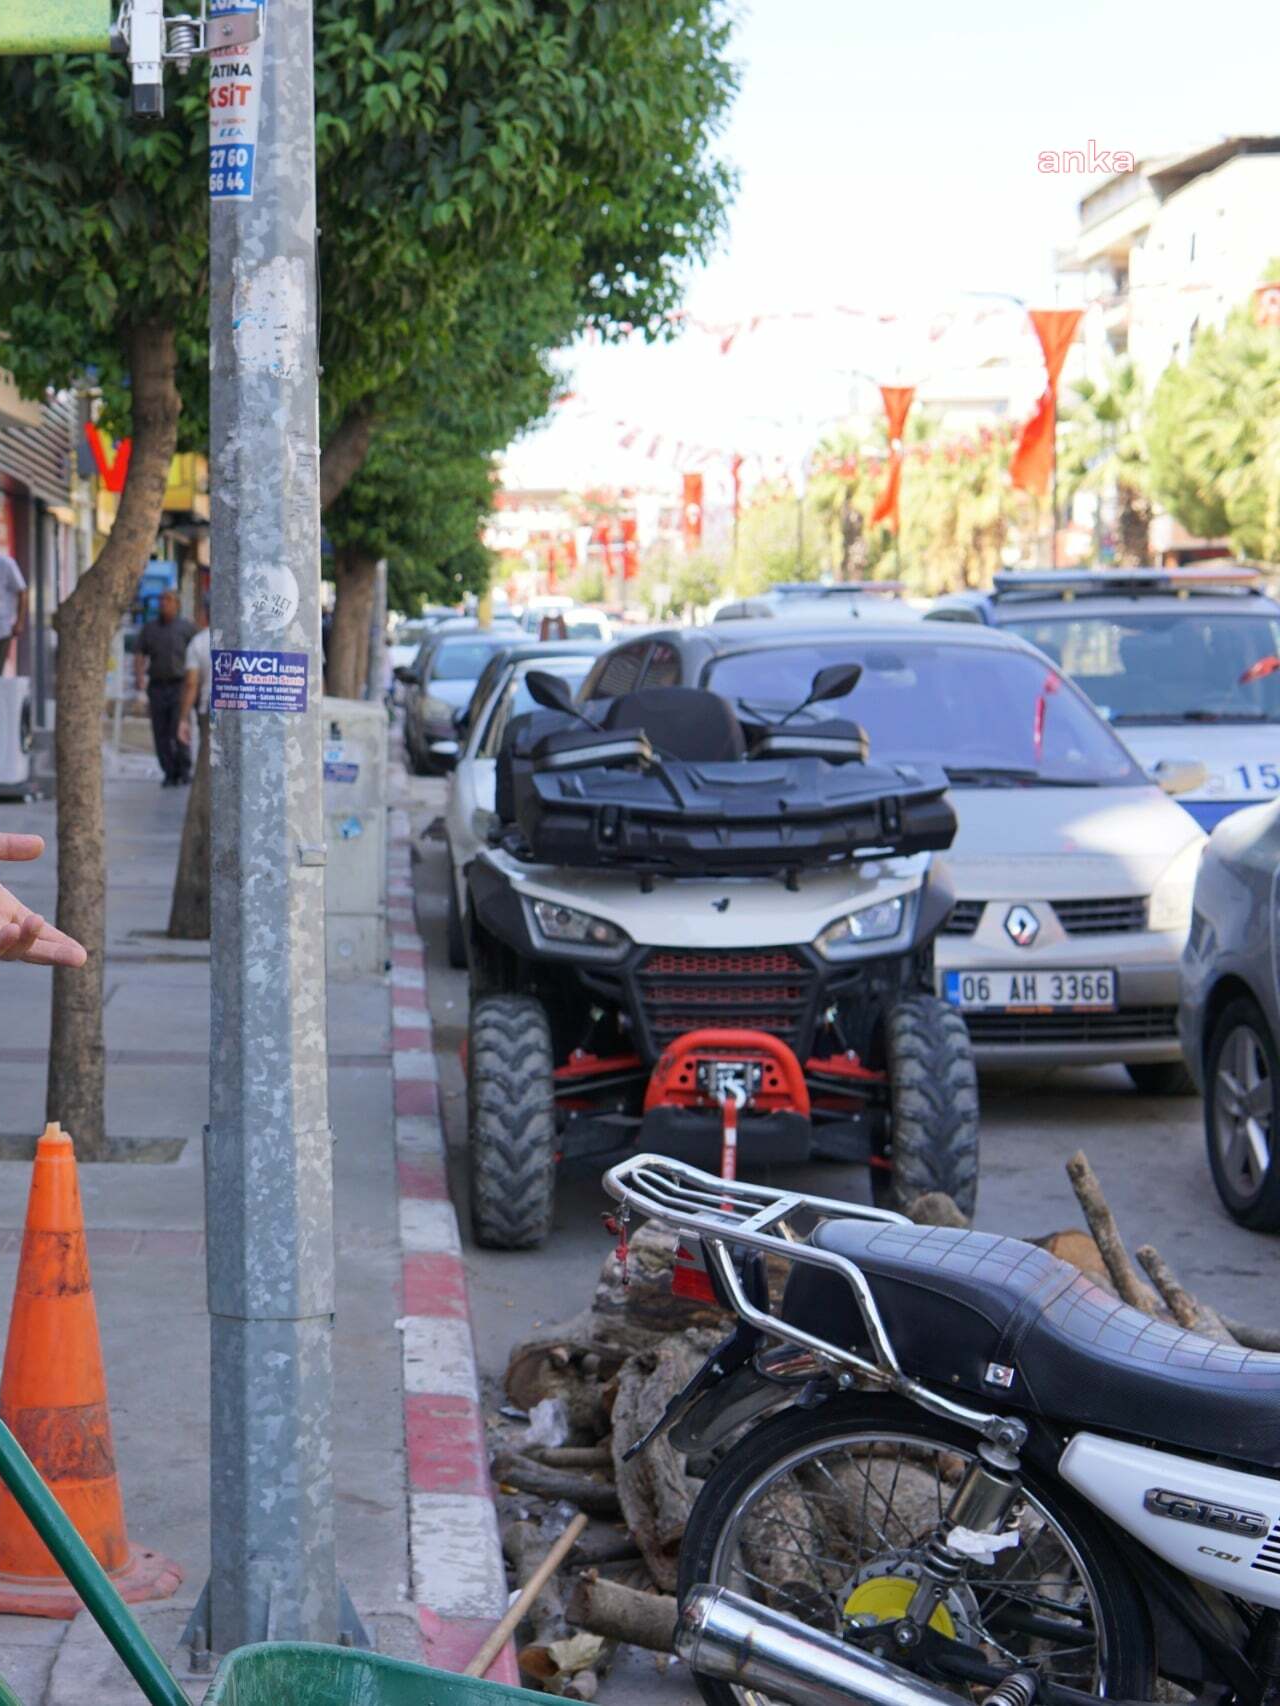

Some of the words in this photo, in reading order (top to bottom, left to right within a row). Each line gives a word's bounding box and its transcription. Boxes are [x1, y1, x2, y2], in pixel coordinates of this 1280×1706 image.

[209, 63, 253, 78] ATINA
[226, 172, 246, 191] 44
[231, 657, 278, 673] AVCI
[962, 975, 991, 1001] 06
[1009, 974, 1038, 1001] AH
[1050, 974, 1111, 1001] 3366
[1196, 1545, 1243, 1564] CDI
